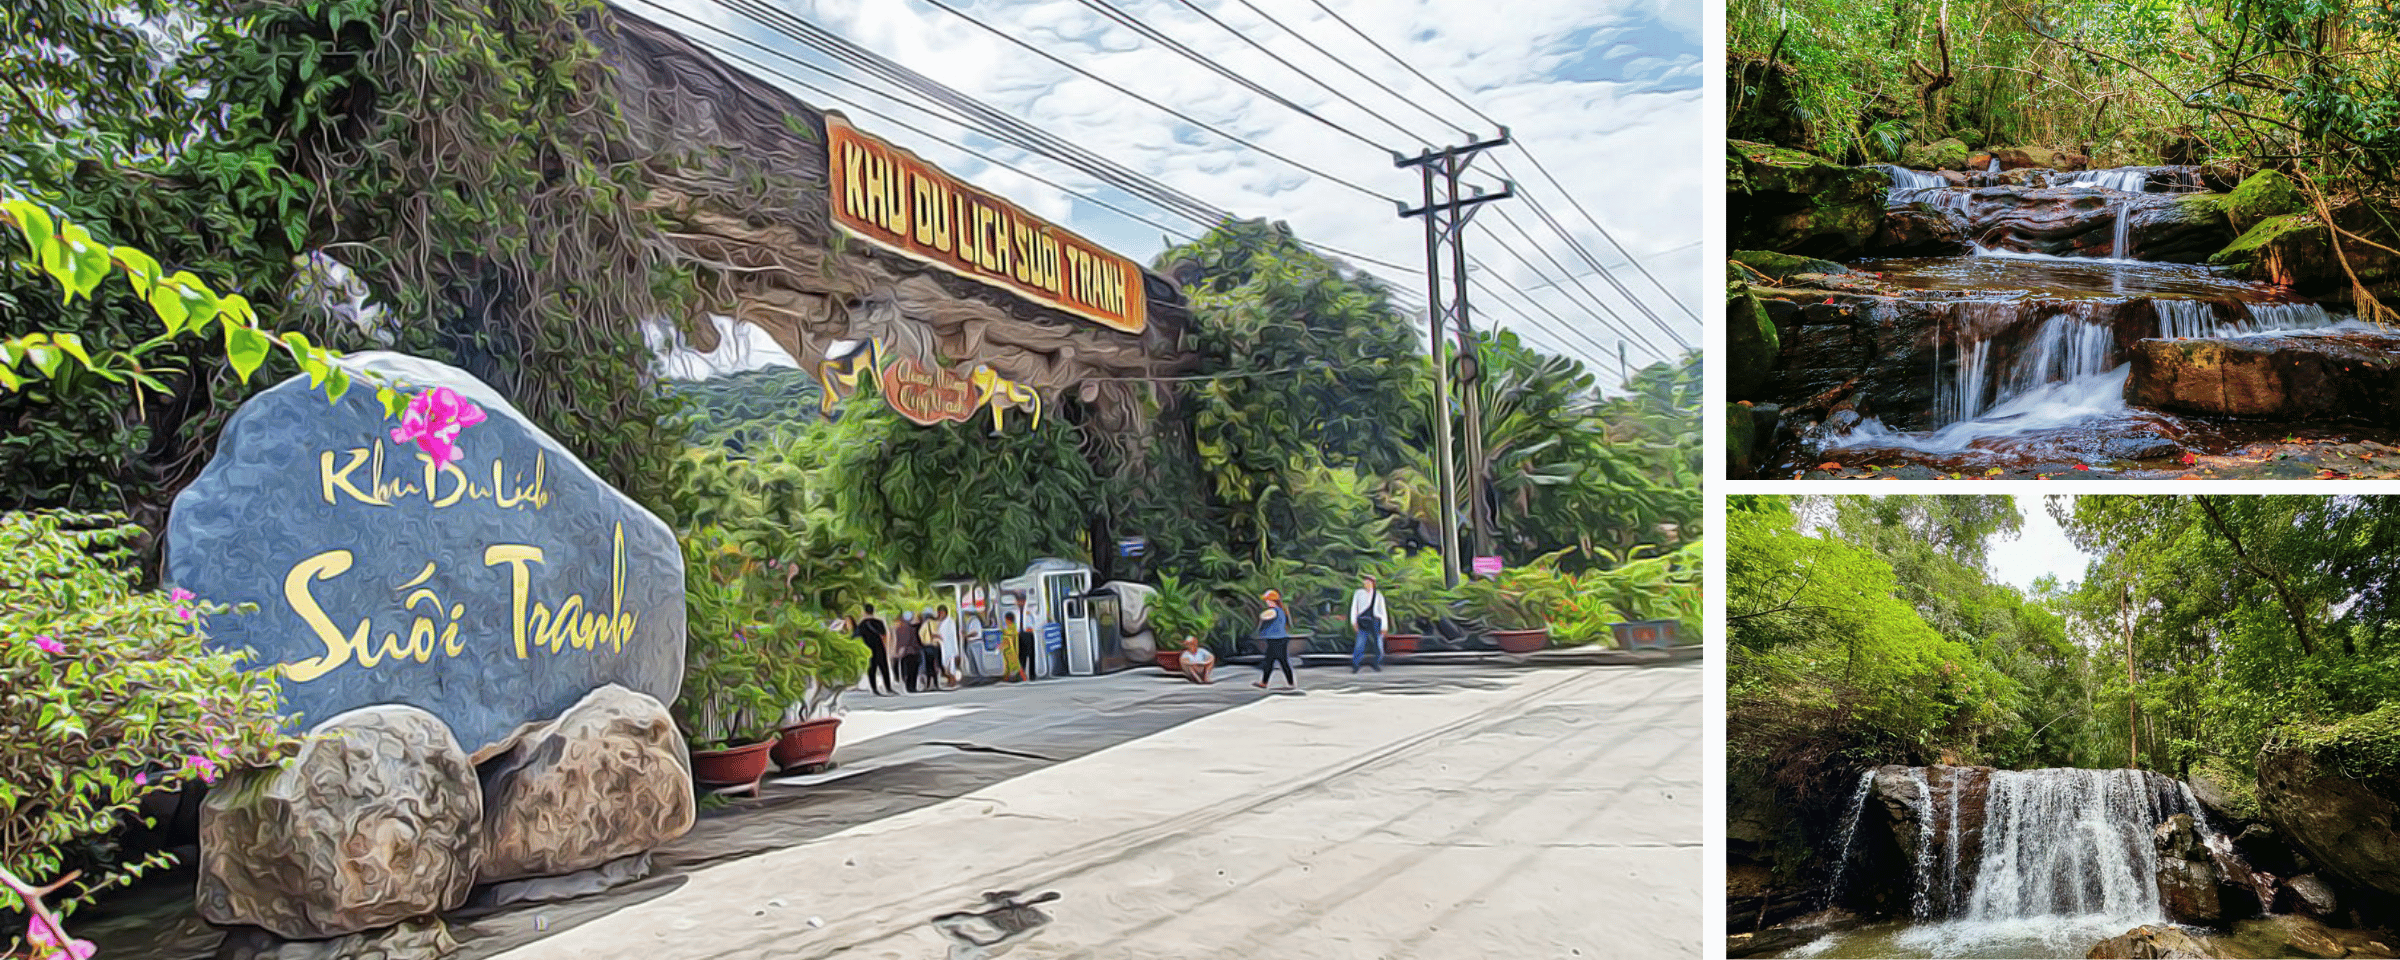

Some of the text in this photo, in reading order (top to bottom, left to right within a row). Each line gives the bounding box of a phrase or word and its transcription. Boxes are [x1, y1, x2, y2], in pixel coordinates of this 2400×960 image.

[844, 138, 908, 237] KHU
[913, 171, 951, 253] DU
[1065, 243, 1126, 318] TRANH
[320, 437, 422, 507] Khu
[415, 452, 492, 509] Du
[282, 519, 640, 682] Suối Tranh
